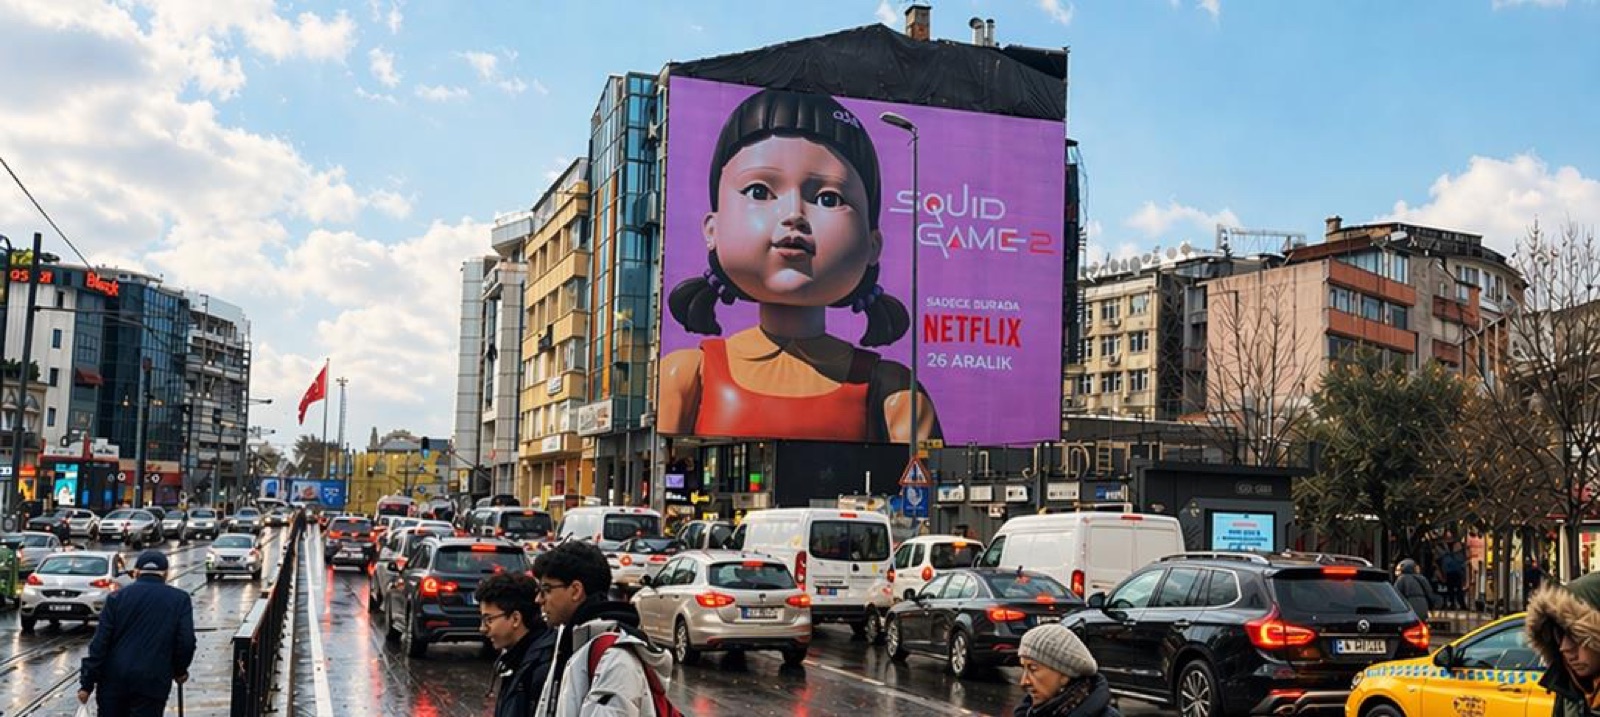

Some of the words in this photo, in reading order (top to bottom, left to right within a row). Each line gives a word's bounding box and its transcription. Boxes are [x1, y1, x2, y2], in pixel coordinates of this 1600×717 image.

[889, 184, 1006, 224] SQUID
[917, 224, 1026, 259] GAME
[1028, 231, 1055, 254] 2
[924, 314, 1021, 348] NETFLIX
[927, 353, 948, 368] 26
[952, 355, 1013, 370] ARALIK
